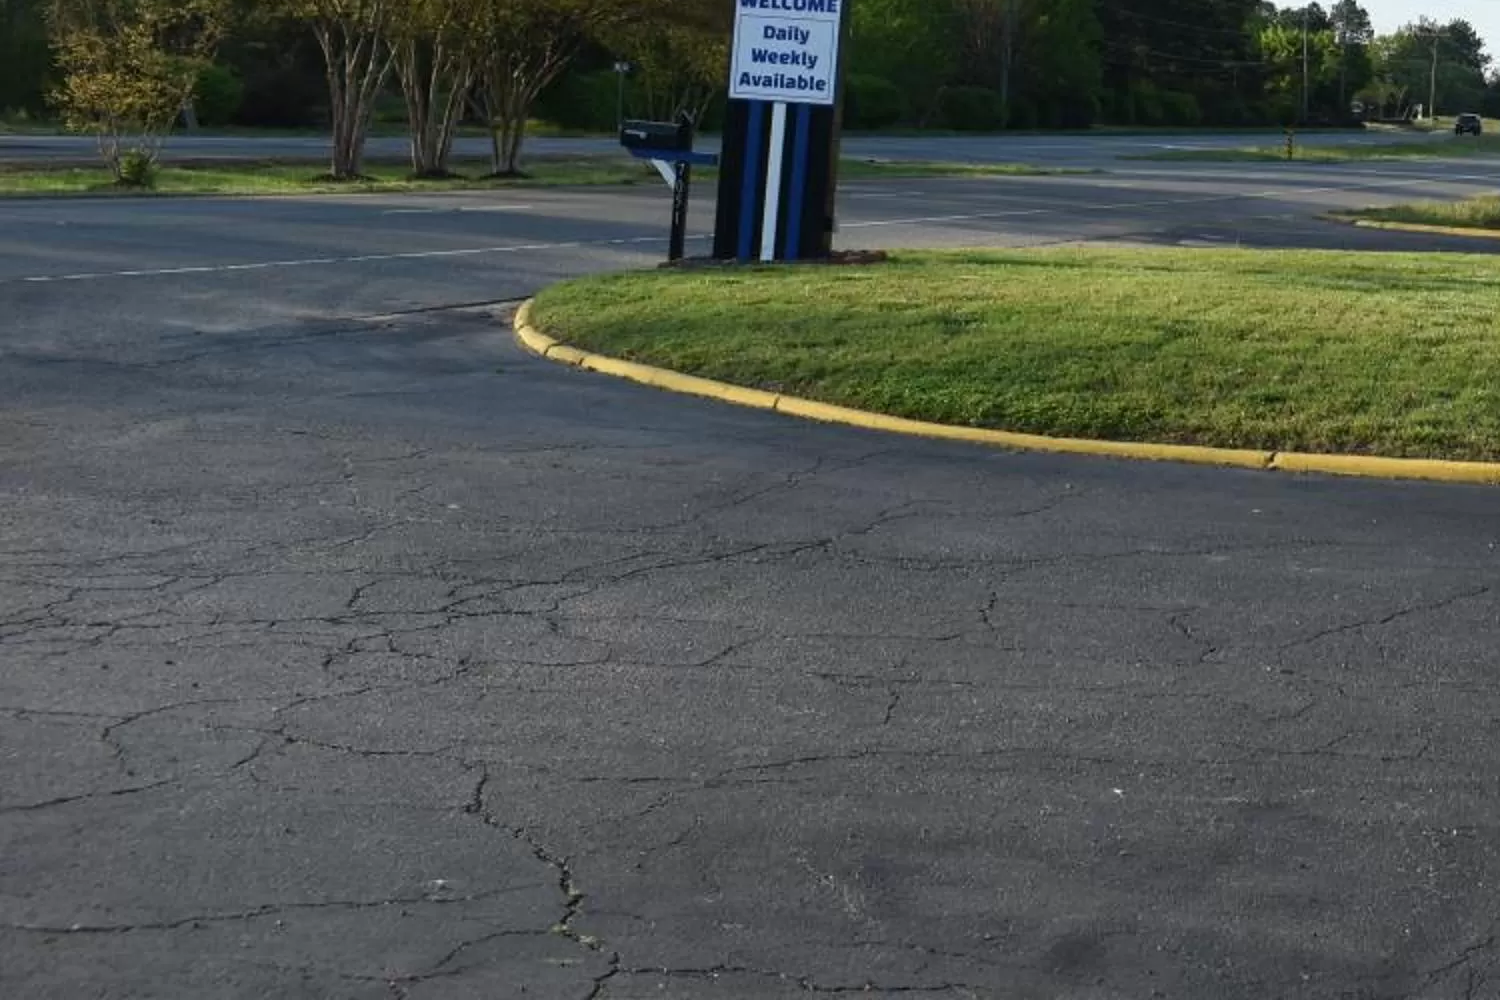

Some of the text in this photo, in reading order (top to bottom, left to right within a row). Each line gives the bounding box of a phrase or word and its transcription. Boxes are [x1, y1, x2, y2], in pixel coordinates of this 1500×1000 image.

[763, 25, 810, 45] Daily
[751, 47, 818, 69] Weekly
[739, 72, 826, 91] Available
